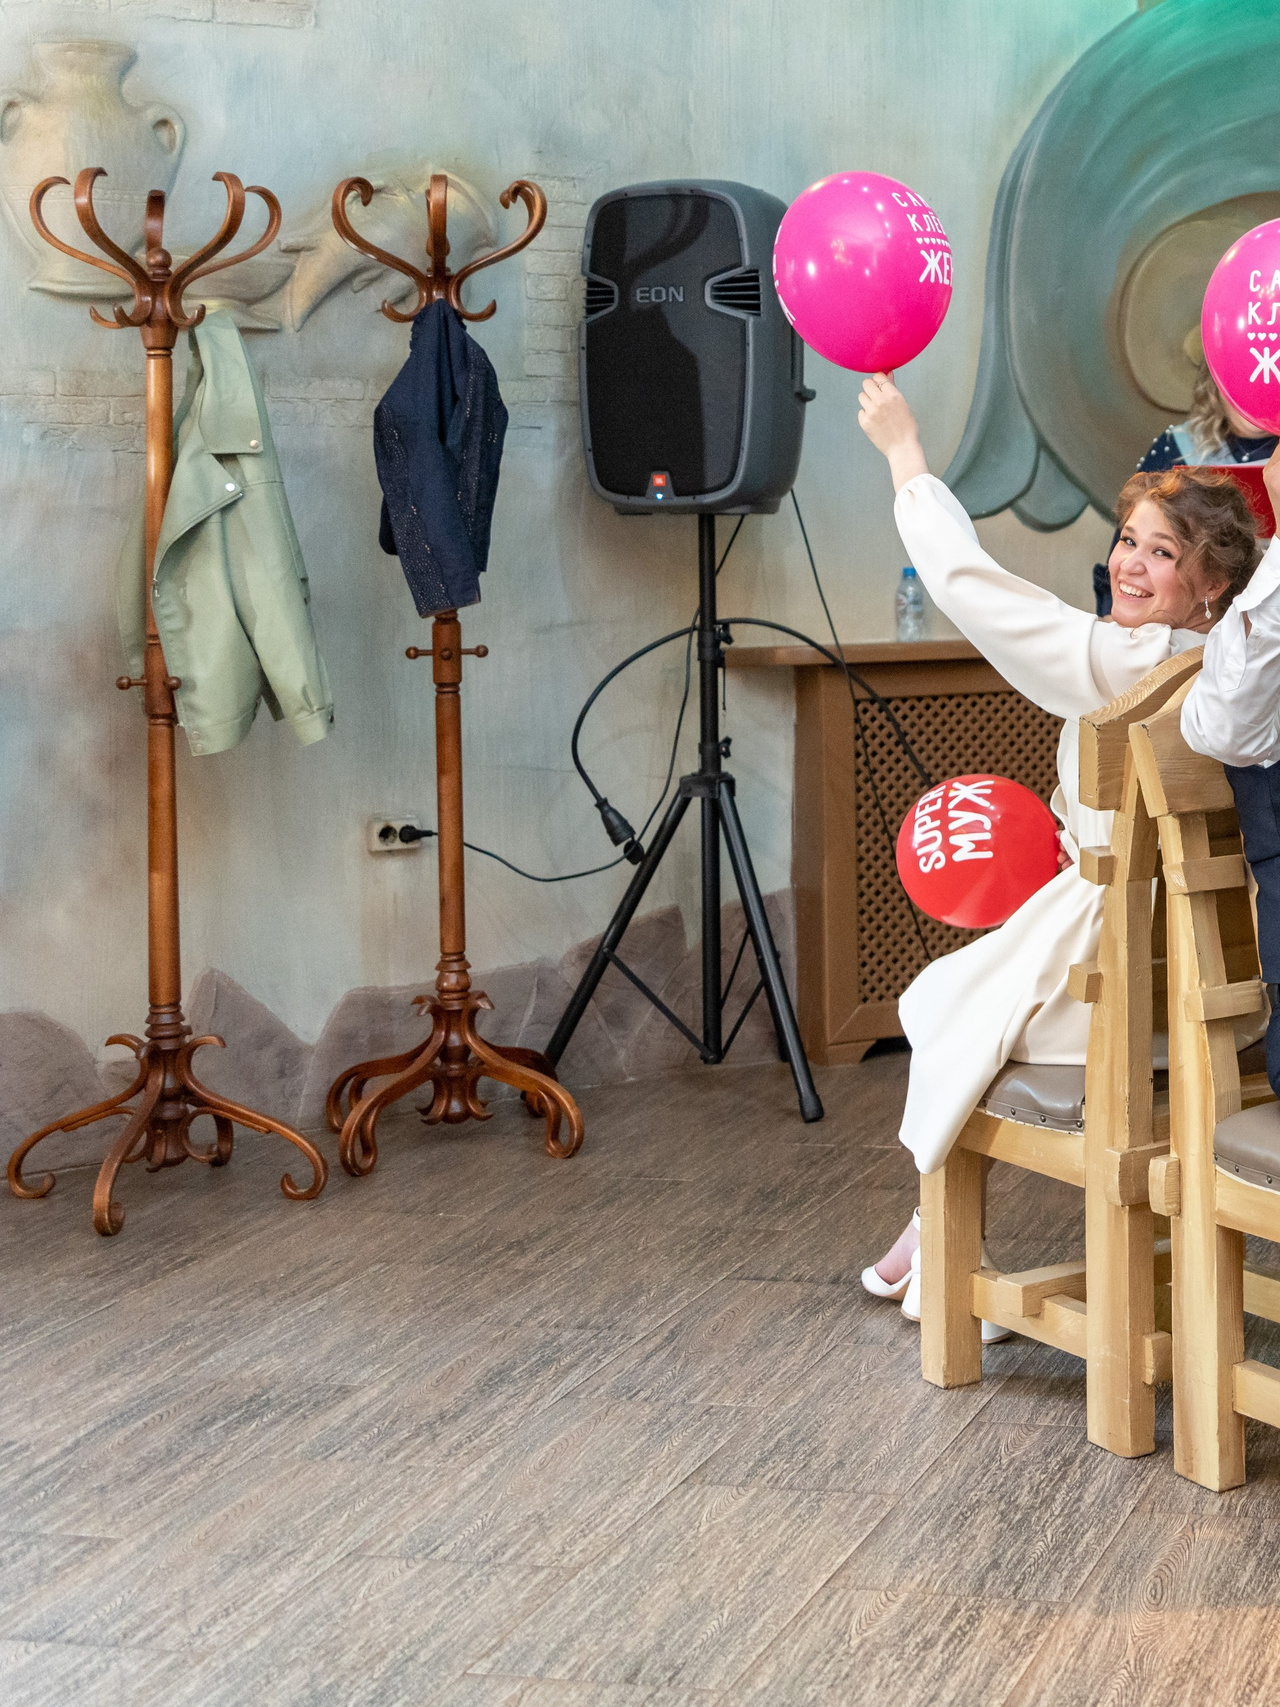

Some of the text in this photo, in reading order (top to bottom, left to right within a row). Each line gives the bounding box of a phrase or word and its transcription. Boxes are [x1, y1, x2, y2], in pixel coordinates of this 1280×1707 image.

[906, 211, 946, 235] КЛЁ
[636, 286, 684, 303] EON
[914, 785, 947, 873] SUPER
[948, 780, 995, 862] МУЖ
